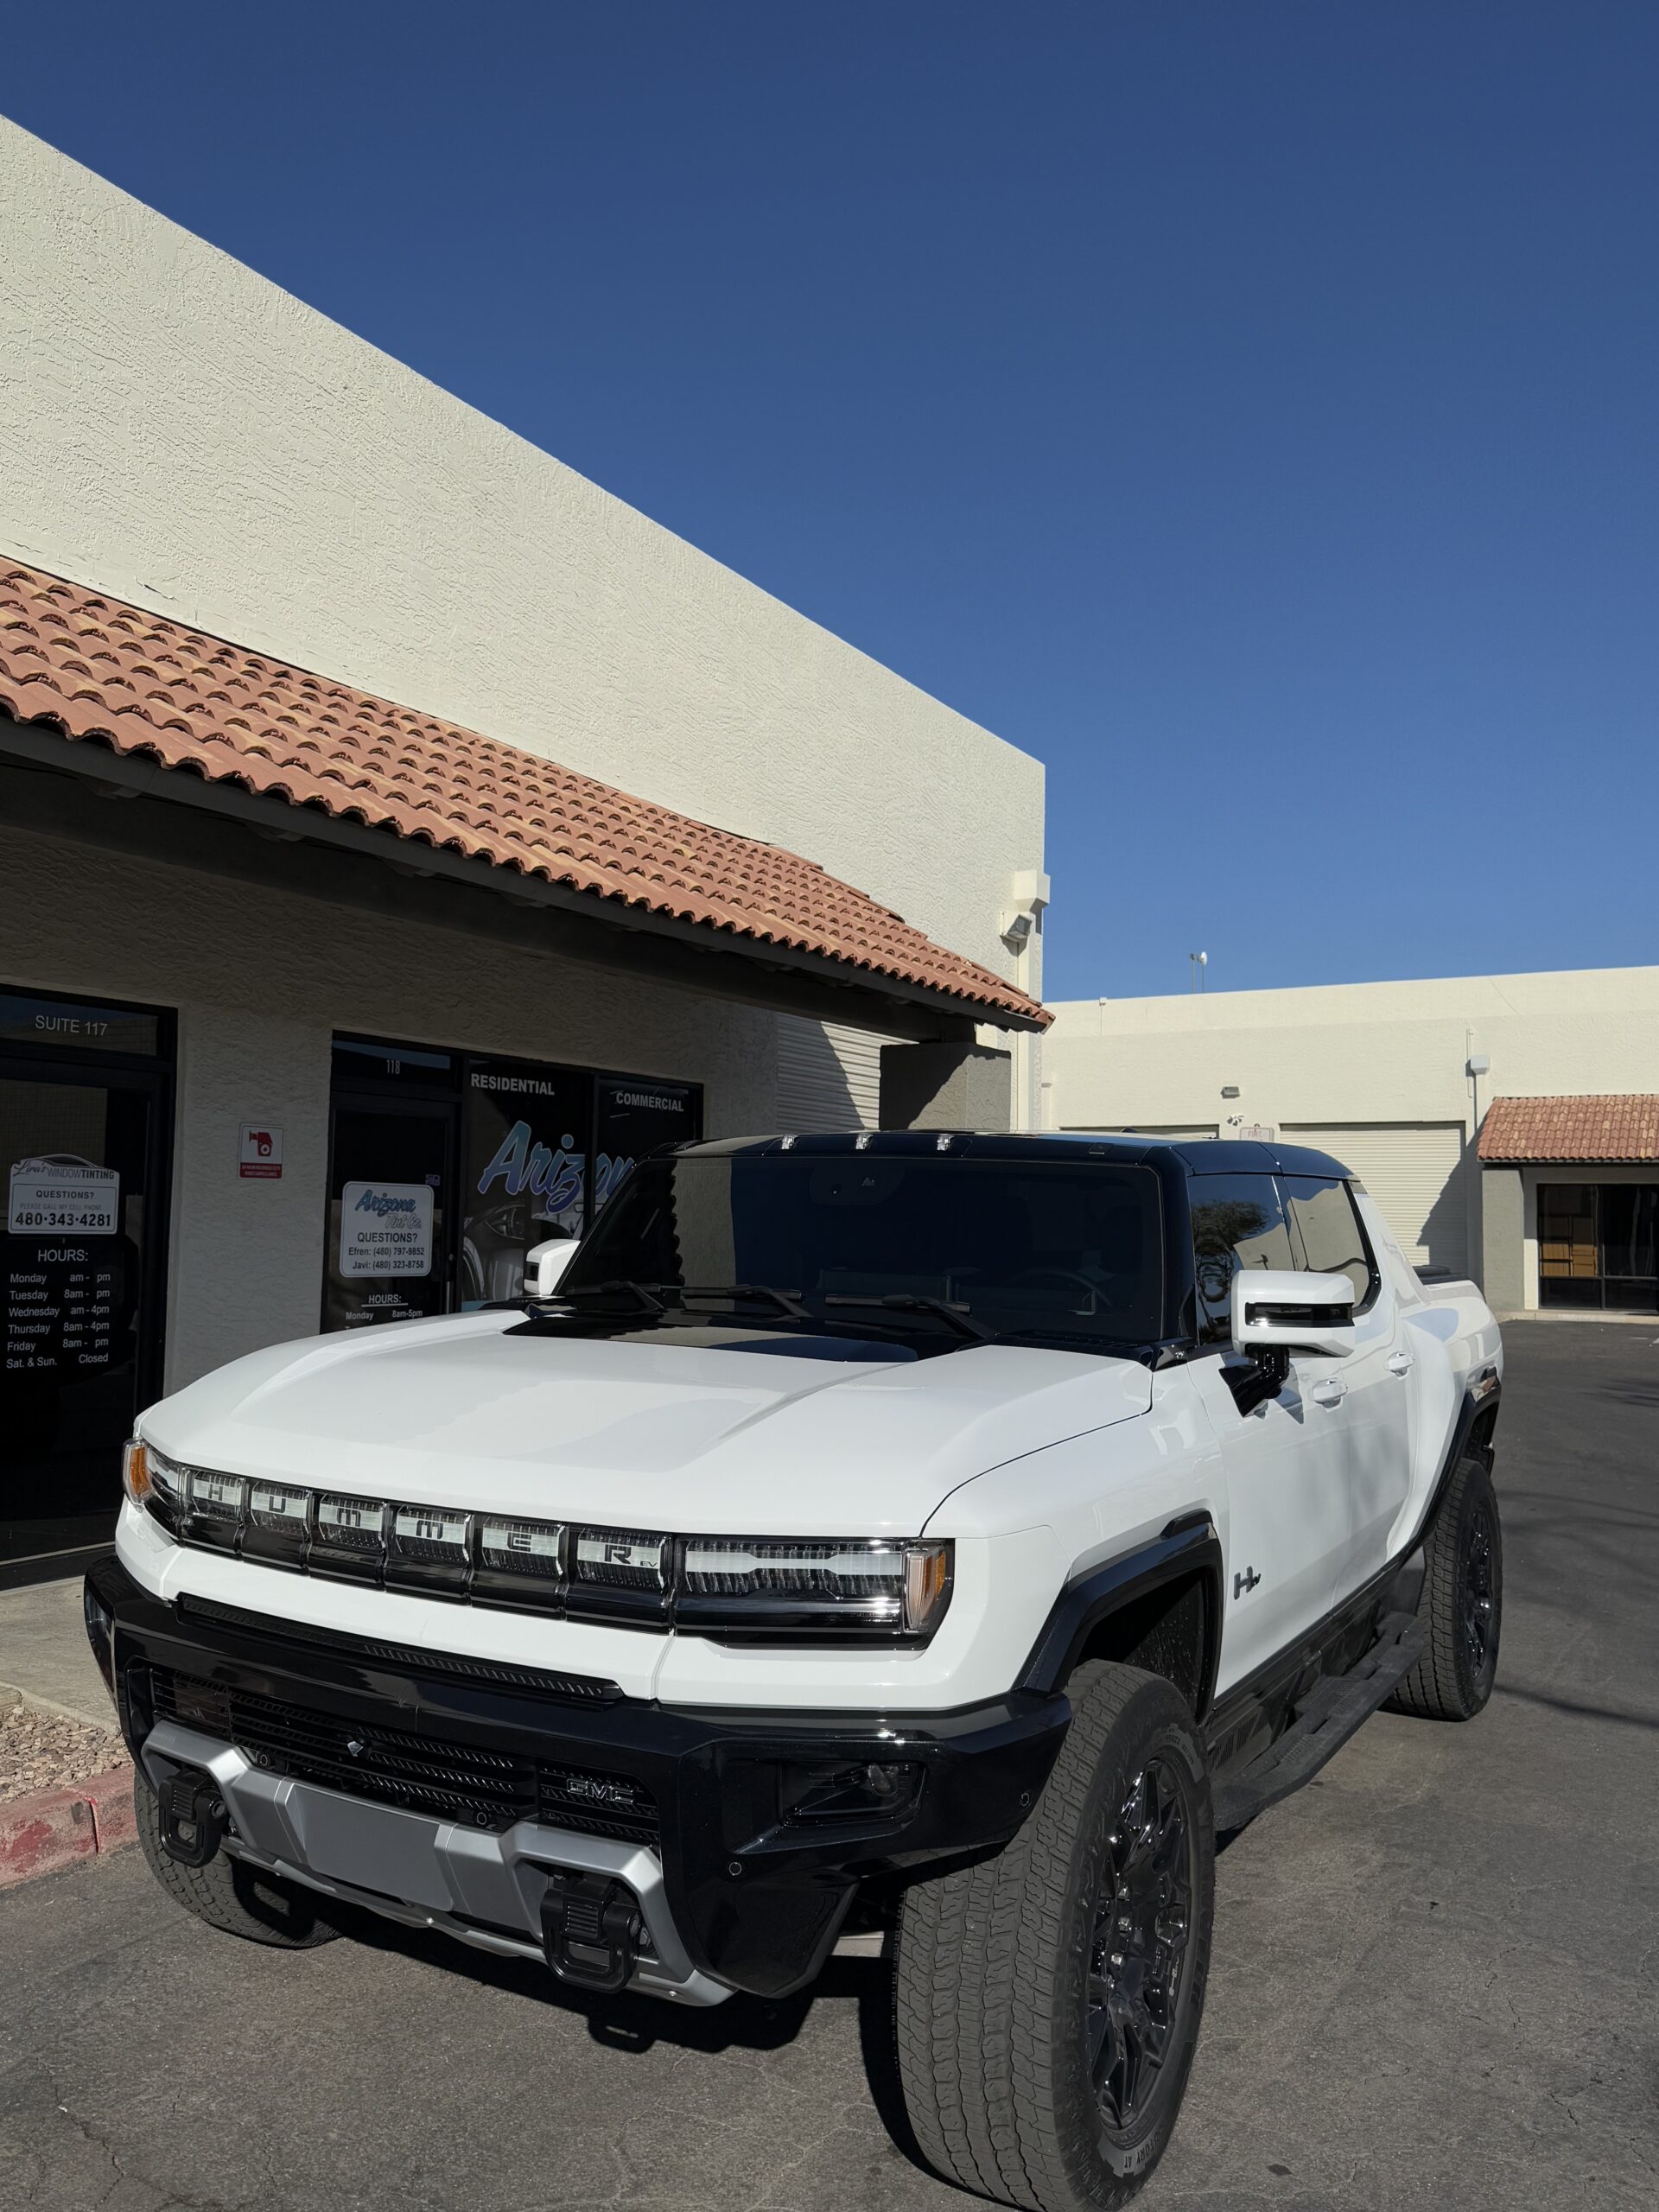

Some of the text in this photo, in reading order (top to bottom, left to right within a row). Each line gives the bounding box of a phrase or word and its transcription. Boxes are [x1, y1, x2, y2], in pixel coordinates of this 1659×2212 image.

[35, 1014, 108, 1036] SUITE 117
[386, 1059, 401, 1075] 118
[470, 1072, 555, 1096] RESIDENTIAL
[615, 1091, 684, 1112] COMMERCIAL
[35, 1190, 95, 1199] QUESTIONS?
[354, 1189, 416, 1217] Arizona
[357, 1232, 418, 1243] QUESTIONS?
[37, 1249, 88, 1262] HOURS:
[348, 1247, 425, 1257] Efren: (480) 797-9852
[352, 1260, 424, 1271] Javi: (480) 323-8758
[10, 1273, 48, 1285] Monday
[69, 1274, 84, 1282] am
[96, 1274, 111, 1284] pm
[10, 1289, 48, 1301] Tuesday
[64, 1288, 84, 1299] 8am
[96, 1289, 111, 1300] pm
[368, 1294, 402, 1304] HOURS:
[8, 1306, 60, 1318] Wednesday
[70, 1306, 85, 1315] am
[91, 1305, 110, 1316] 4pm
[346, 1311, 374, 1321] Monday
[8, 1324, 51, 1335] Thursday
[63, 1322, 83, 1332] 8am
[90, 1321, 110, 1332] 4pm
[7, 1341, 36, 1353] Friday
[62, 1339, 82, 1348] 8am
[95, 1338, 109, 1348] pm
[6, 1353, 109, 1369] Sat. & Sun. Closed
[566, 1777, 634, 1805] GMC
[1124, 2155, 1133, 2168] AT
